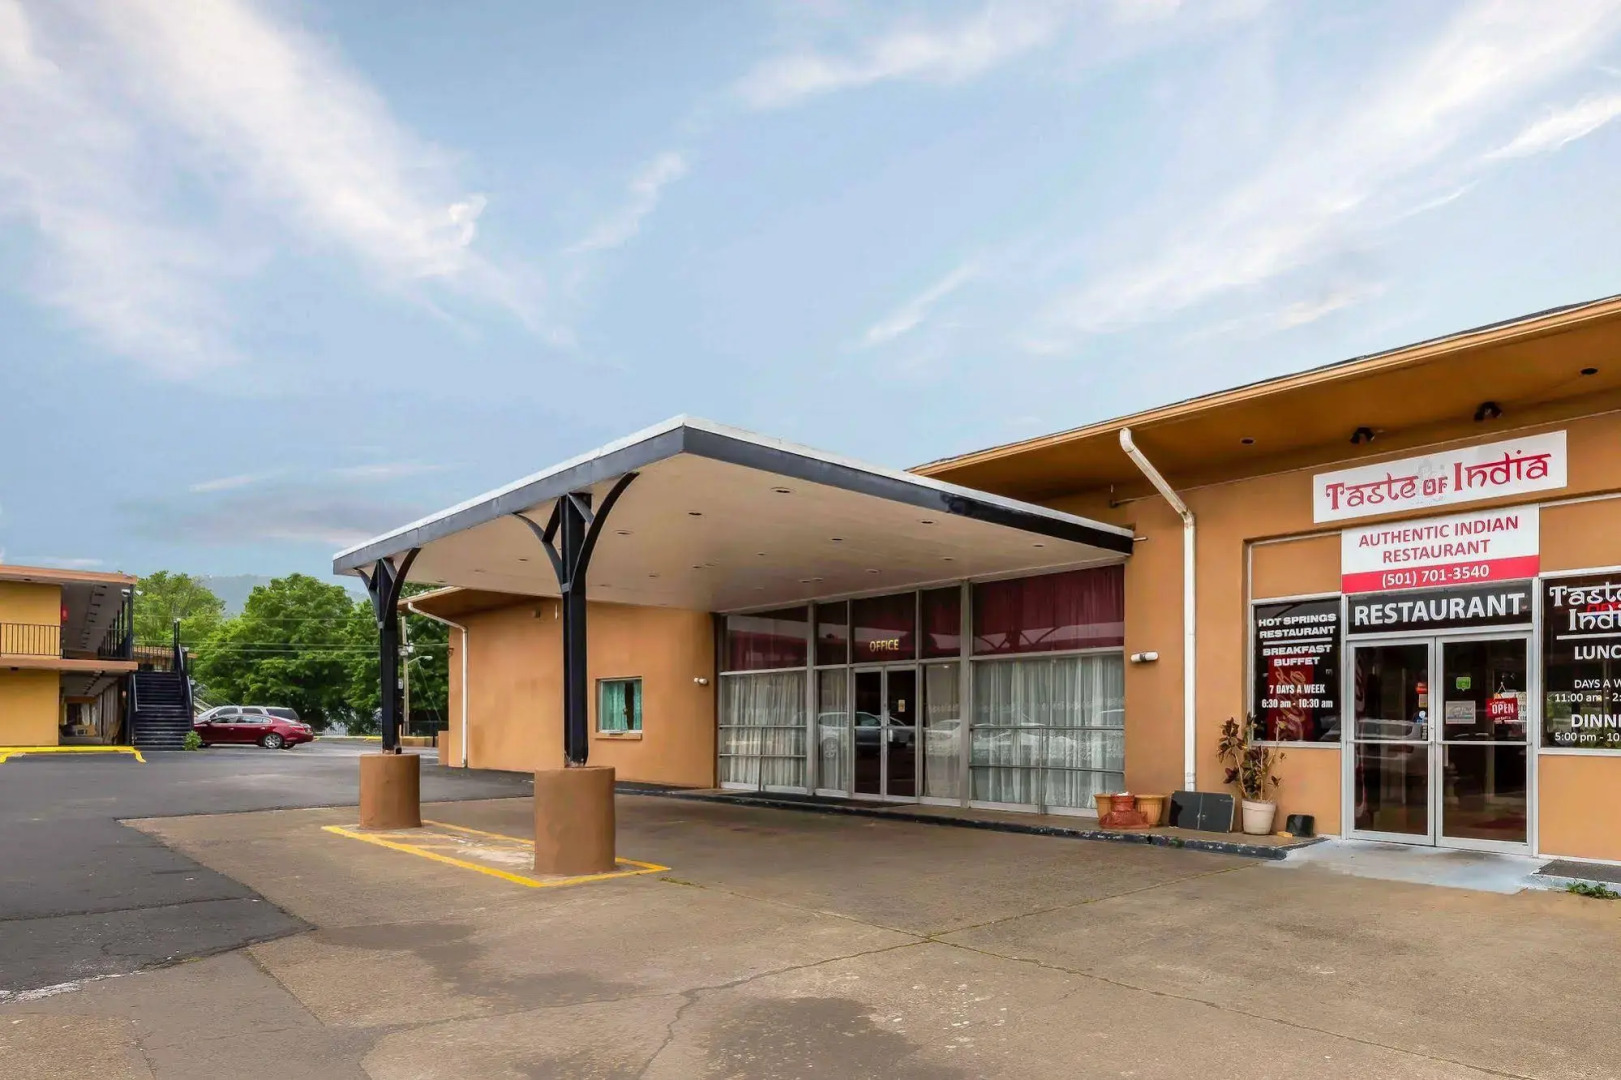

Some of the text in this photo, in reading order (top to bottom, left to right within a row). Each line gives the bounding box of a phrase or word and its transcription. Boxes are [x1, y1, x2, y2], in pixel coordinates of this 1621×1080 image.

[1326, 472, 1418, 510] Taste
[1454, 450, 1552, 491] India
[1358, 516, 1518, 548] AUTHENTIC INDIAN
[1382, 539, 1490, 563] RESTAURANT
[1382, 564, 1489, 589] (501) 701-3540
[1354, 593, 1525, 626] RESTAURANT
[1258, 614, 1336, 627] HOT SPRINGS
[1260, 626, 1336, 638] RESTAURANT
[870, 639, 899, 652] OFFICE
[1263, 644, 1332, 656] BREAKFAST
[1274, 657, 1320, 667] BUFFET
[1269, 684, 1325, 694] 7 DAYS A WEEK
[1574, 679, 1600, 688] DAYS
[1603, 679, 1610, 688] A
[1262, 699, 1278, 708] 6:30
[1280, 700, 1291, 708] am
[1298, 698, 1319, 708] 10:30
[1321, 700, 1333, 708] am
[1555, 693, 1583, 702] 11:00
[1586, 693, 1602, 702] am
[1492, 703, 1514, 714] OPEN
[1571, 714, 1621, 728] DINN
[1555, 732, 1577, 741] 5:00
[1580, 734, 1596, 743] pm
